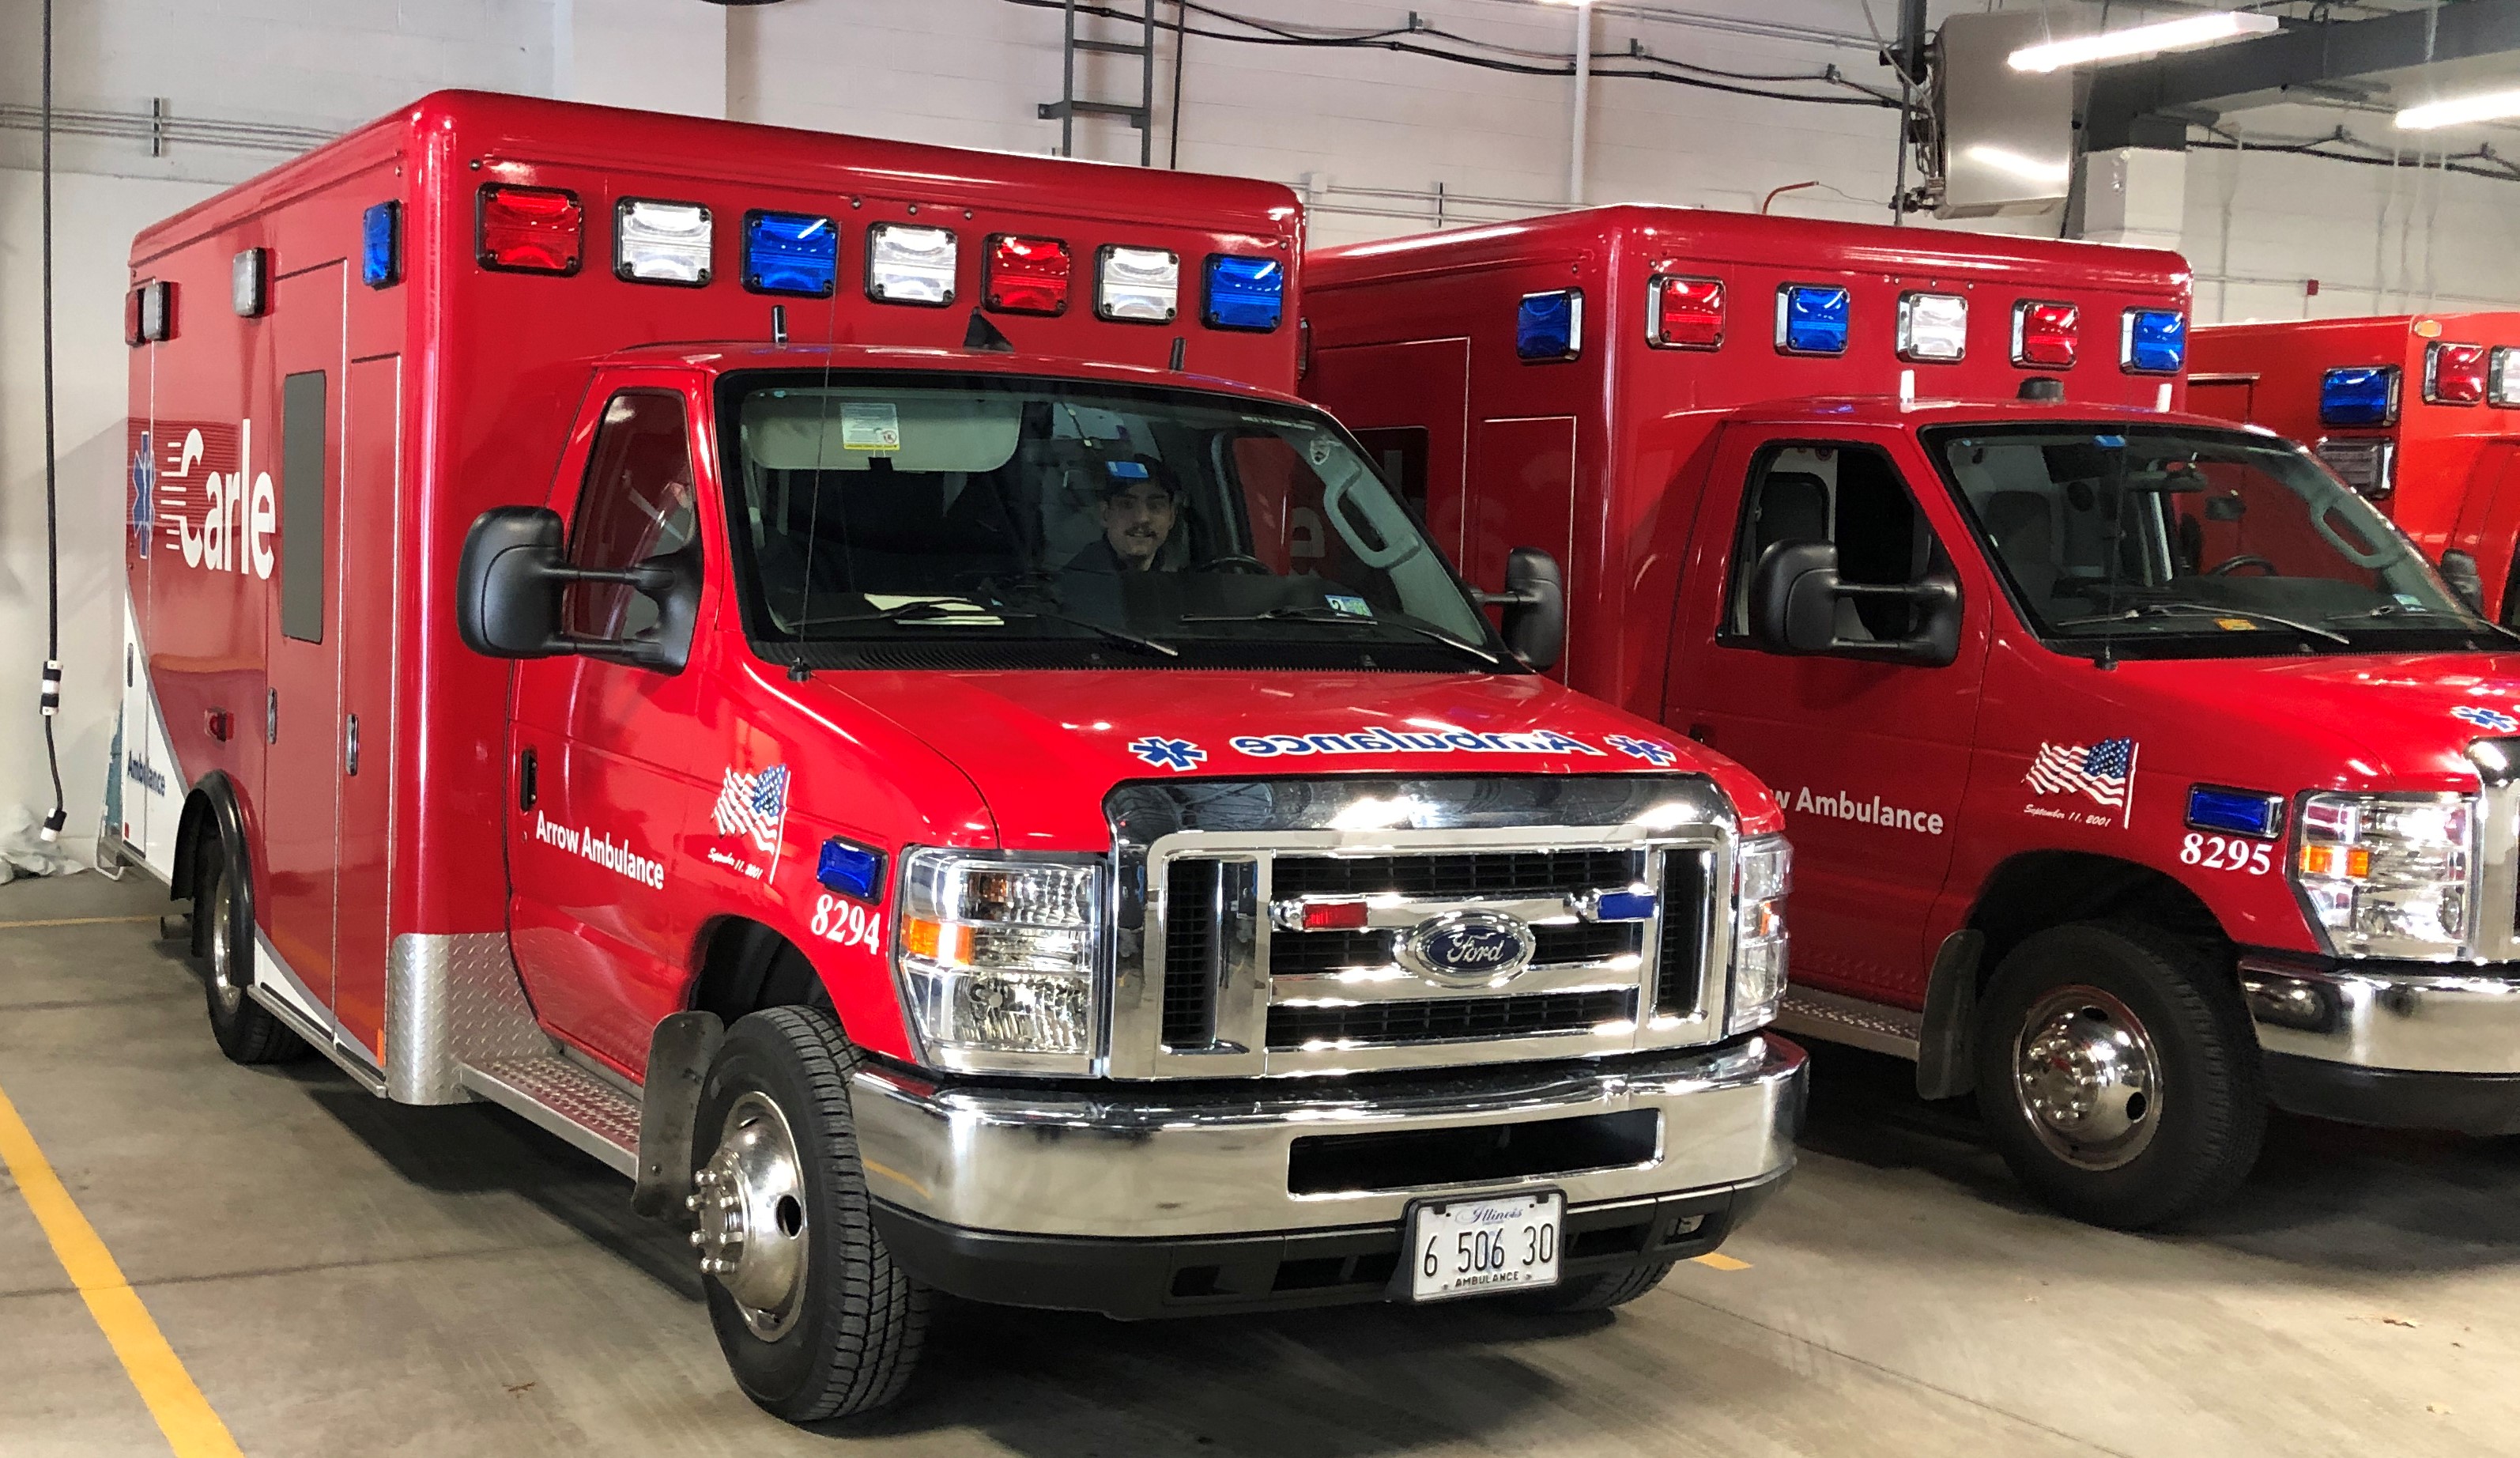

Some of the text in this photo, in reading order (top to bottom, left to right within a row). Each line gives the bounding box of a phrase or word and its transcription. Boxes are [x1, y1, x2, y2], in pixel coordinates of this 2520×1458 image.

[160, 418, 276, 580] Carle
[1795, 786, 1944, 835] Ambulance
[2086, 814, 2111, 828] 2001
[536, 810, 664, 890] Arrow Ambulance
[2180, 833, 2273, 875] 8295
[811, 894, 881, 954] 8294
[1447, 932, 1505, 963] Ford
[1456, 1206, 1523, 1223] Illinois
[1424, 1223, 1554, 1277] 6 506 30
[1454, 1271, 1519, 1288] AMBULANCE
